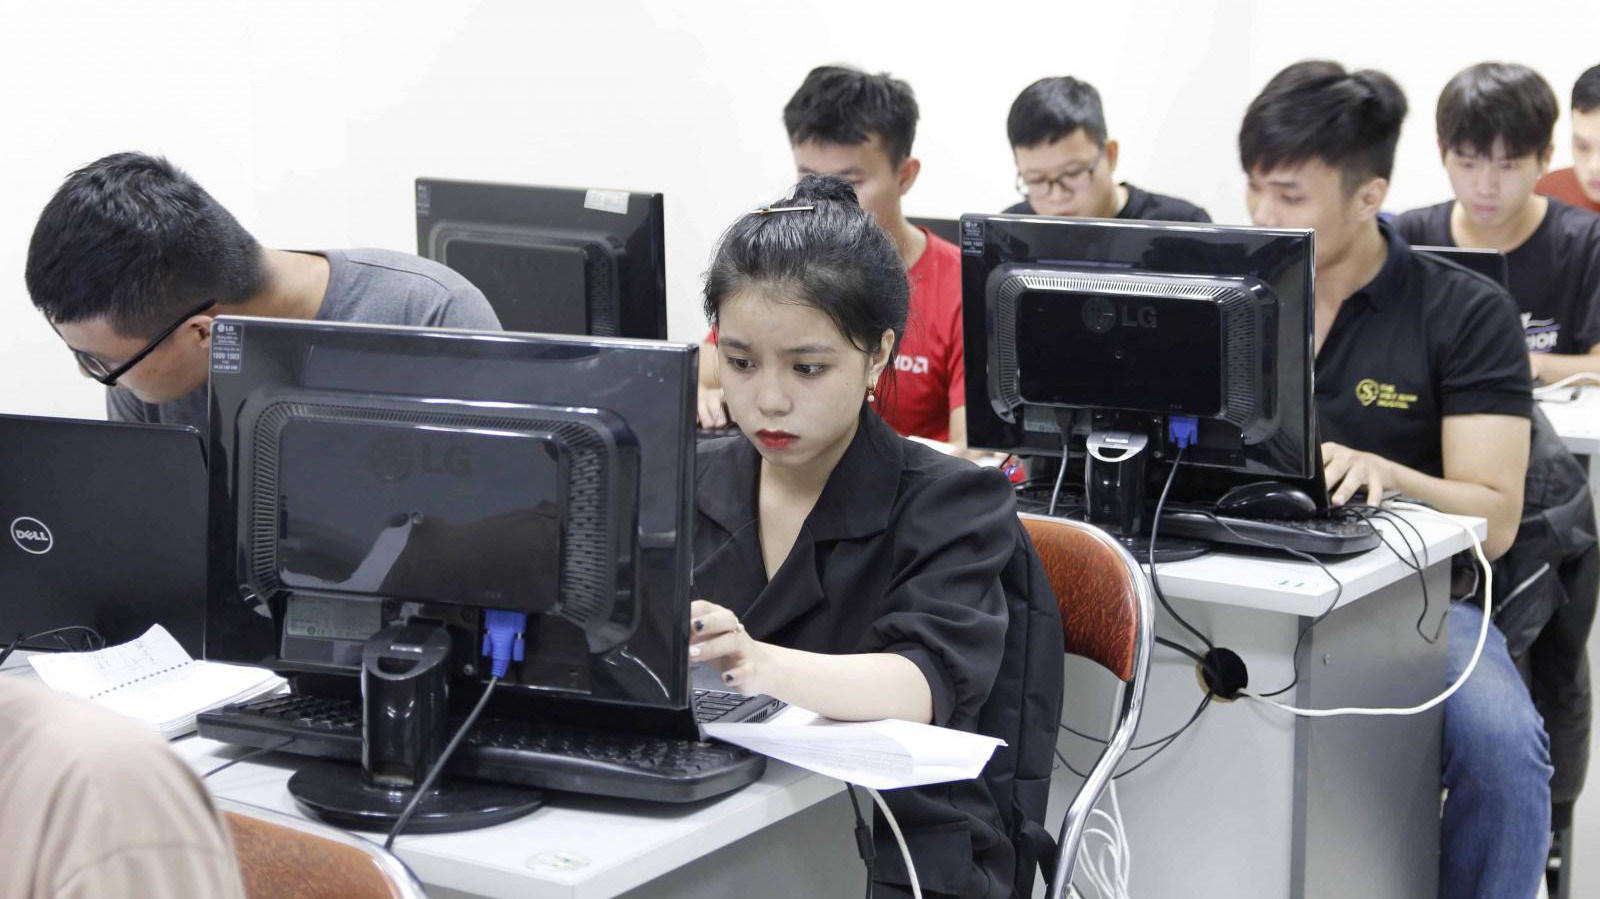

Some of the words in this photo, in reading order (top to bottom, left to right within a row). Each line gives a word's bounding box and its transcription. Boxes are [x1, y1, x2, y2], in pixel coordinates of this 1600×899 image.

[1122, 304, 1157, 329] LG
[421, 442, 473, 476] LG
[15, 529, 49, 541] DELL
